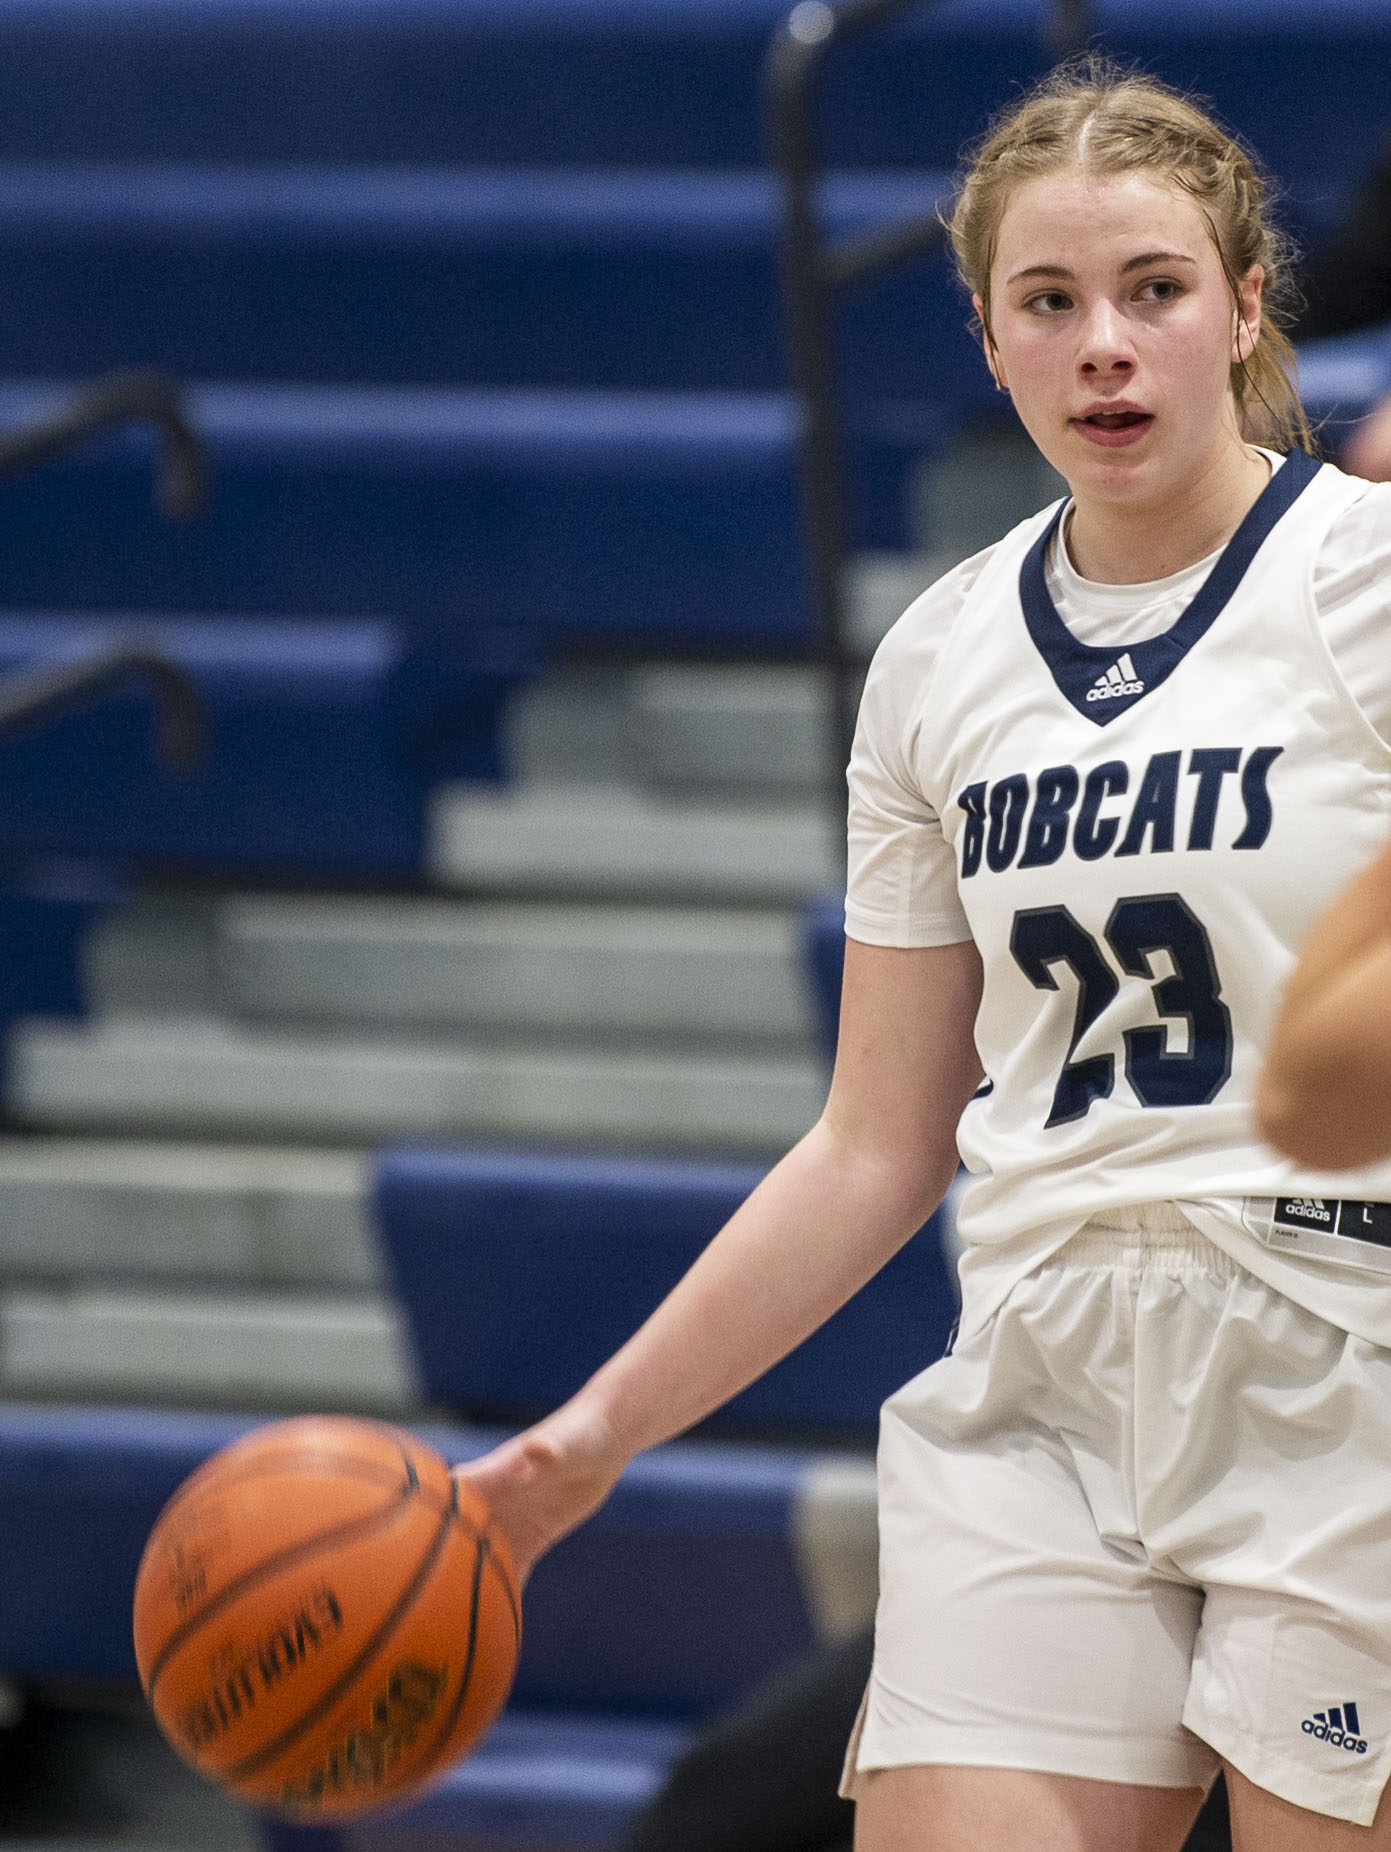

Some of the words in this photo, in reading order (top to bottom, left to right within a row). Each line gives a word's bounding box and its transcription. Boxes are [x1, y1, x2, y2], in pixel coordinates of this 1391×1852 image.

[1086, 680, 1145, 702] adidas
[957, 746, 1285, 880] BOBCATS
[1008, 892, 1235, 1130] 23
[1285, 1203, 1331, 1222] adidas
[1362, 1208, 1373, 1224] L
[1300, 1719, 1368, 1754] adidas
